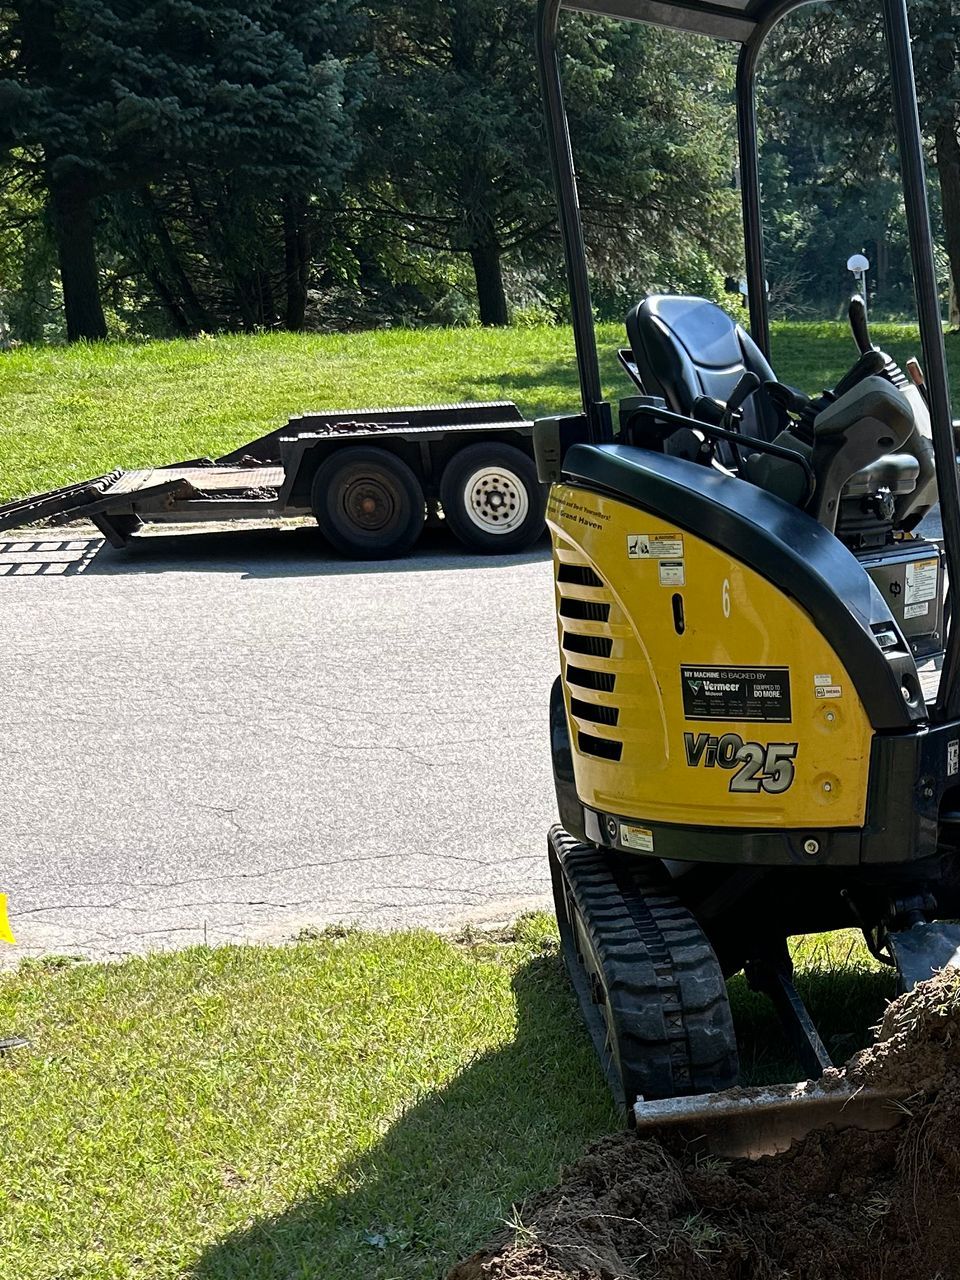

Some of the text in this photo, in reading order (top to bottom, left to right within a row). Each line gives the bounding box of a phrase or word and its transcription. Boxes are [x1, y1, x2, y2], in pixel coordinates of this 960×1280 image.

[560, 509, 578, 522] Grand
[578, 516, 603, 531] Haven
[722, 578, 731, 619] 6
[693, 671, 720, 679] MACHINE
[728, 672, 756, 680] BACKED
[702, 680, 740, 692] Vermeer
[753, 690, 763, 698] DO
